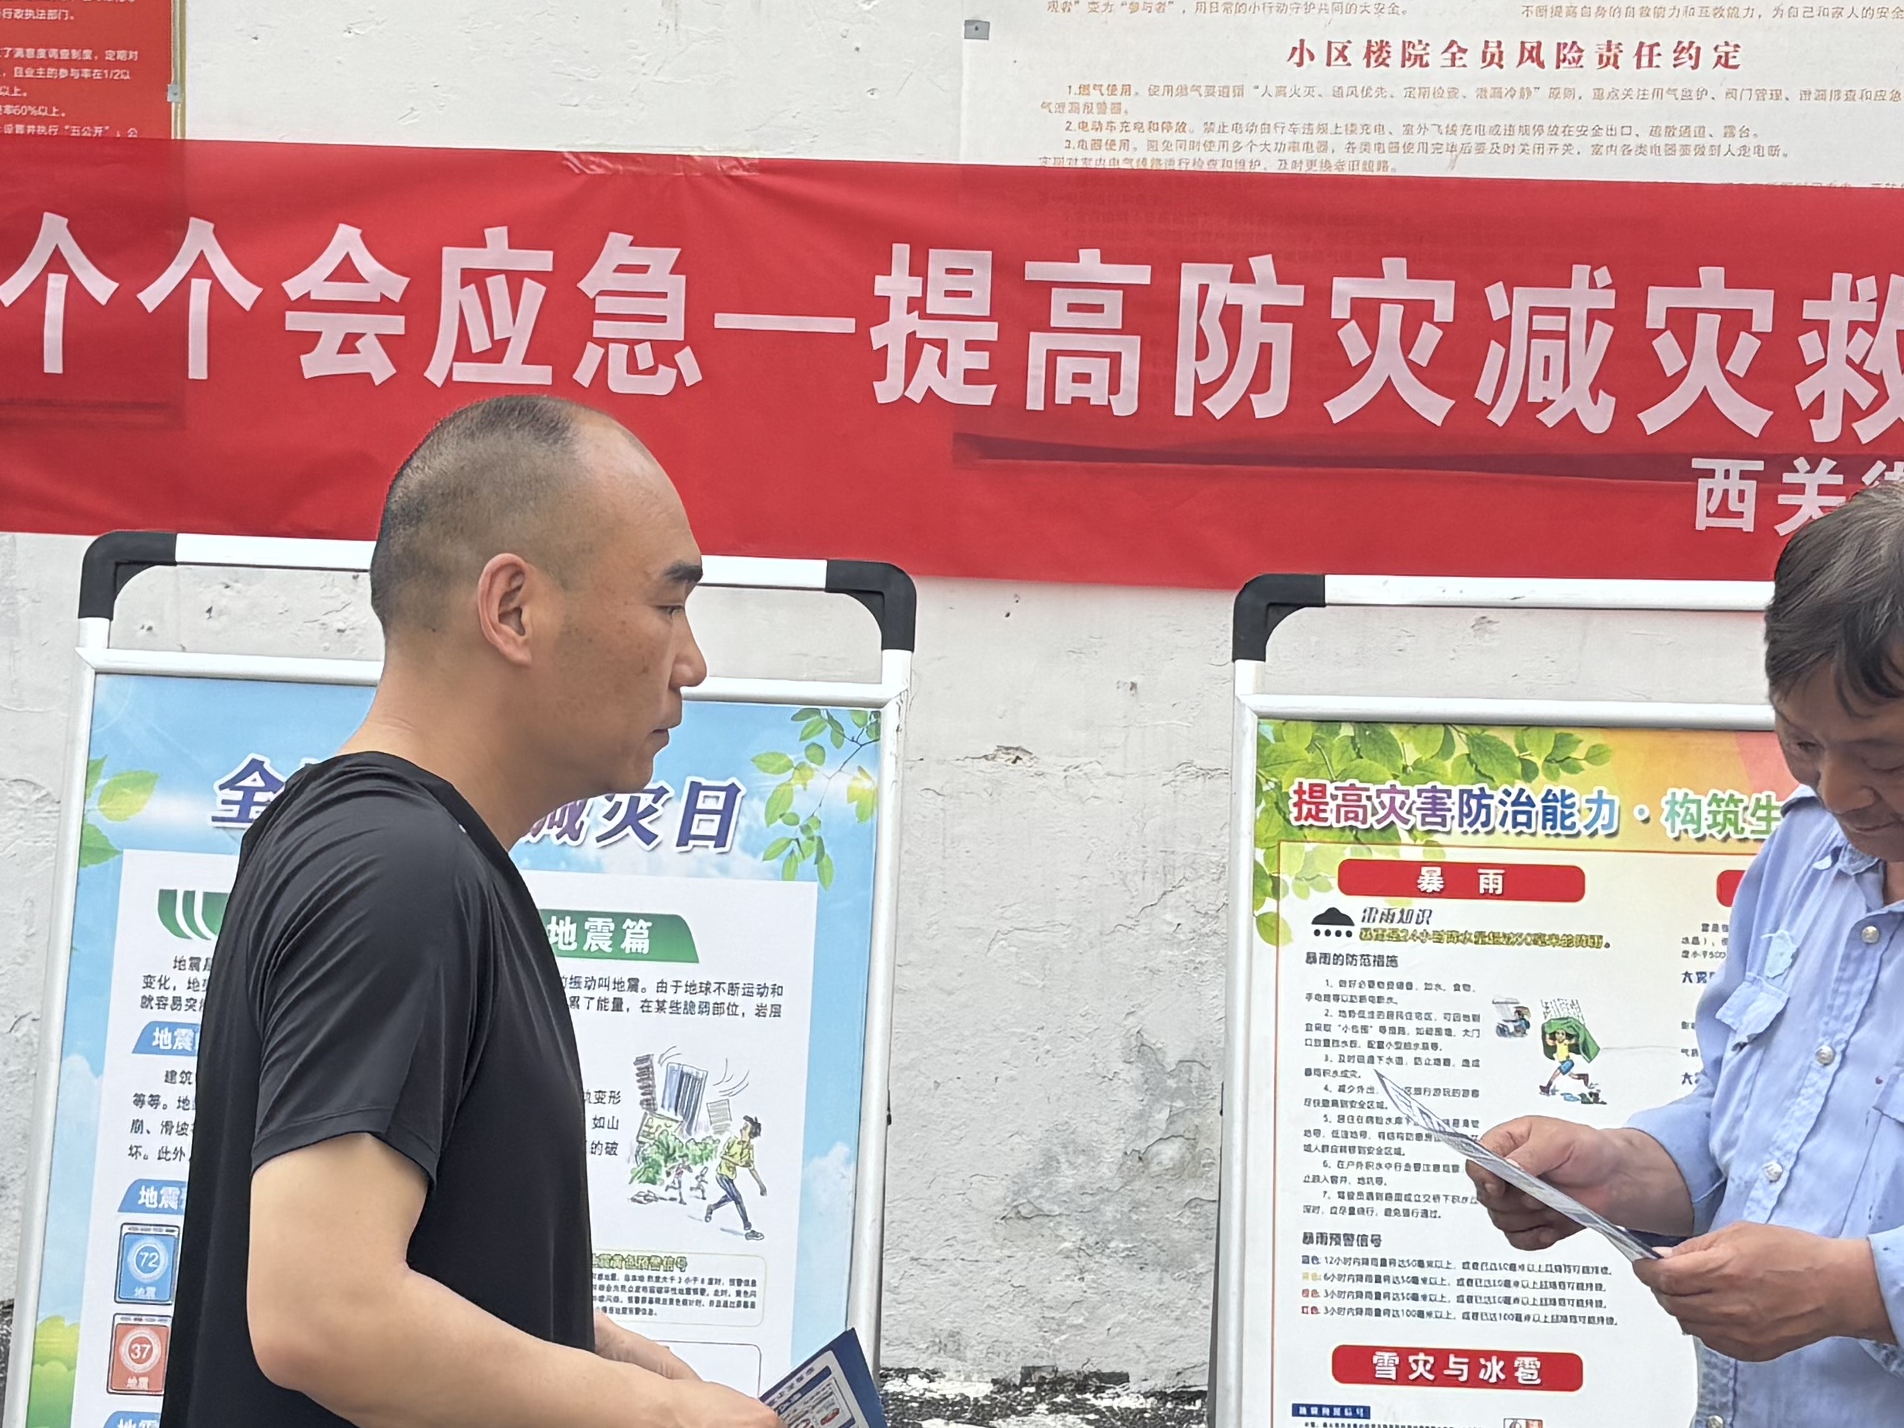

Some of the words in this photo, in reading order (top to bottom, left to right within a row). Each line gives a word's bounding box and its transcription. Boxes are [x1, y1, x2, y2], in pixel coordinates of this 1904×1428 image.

[1286, 38, 1743, 72] 小区楼院全员风险责任约定
[1416, 865, 1505, 896] 暴雨
[547, 916, 653, 955] 地震篇
[1305, 951, 1399, 968] 暴雨的防范措施
[561, 975, 784, 997] 振动叫地震。由于地球不断运动和
[140, 995, 204, 1012] 就容易突
[152, 1027, 199, 1051] 地震
[132, 1092, 196, 1112] 等等。地
[130, 1119, 195, 1137] 崩、滑坡
[591, 1115, 620, 1131] 如山
[1302, 1232, 1383, 1248] 暴雨预警信号
[139, 1252, 158, 1268] 72
[130, 1343, 151, 1359] 37
[1371, 1350, 1542, 1385] 雪灾与冰雹
